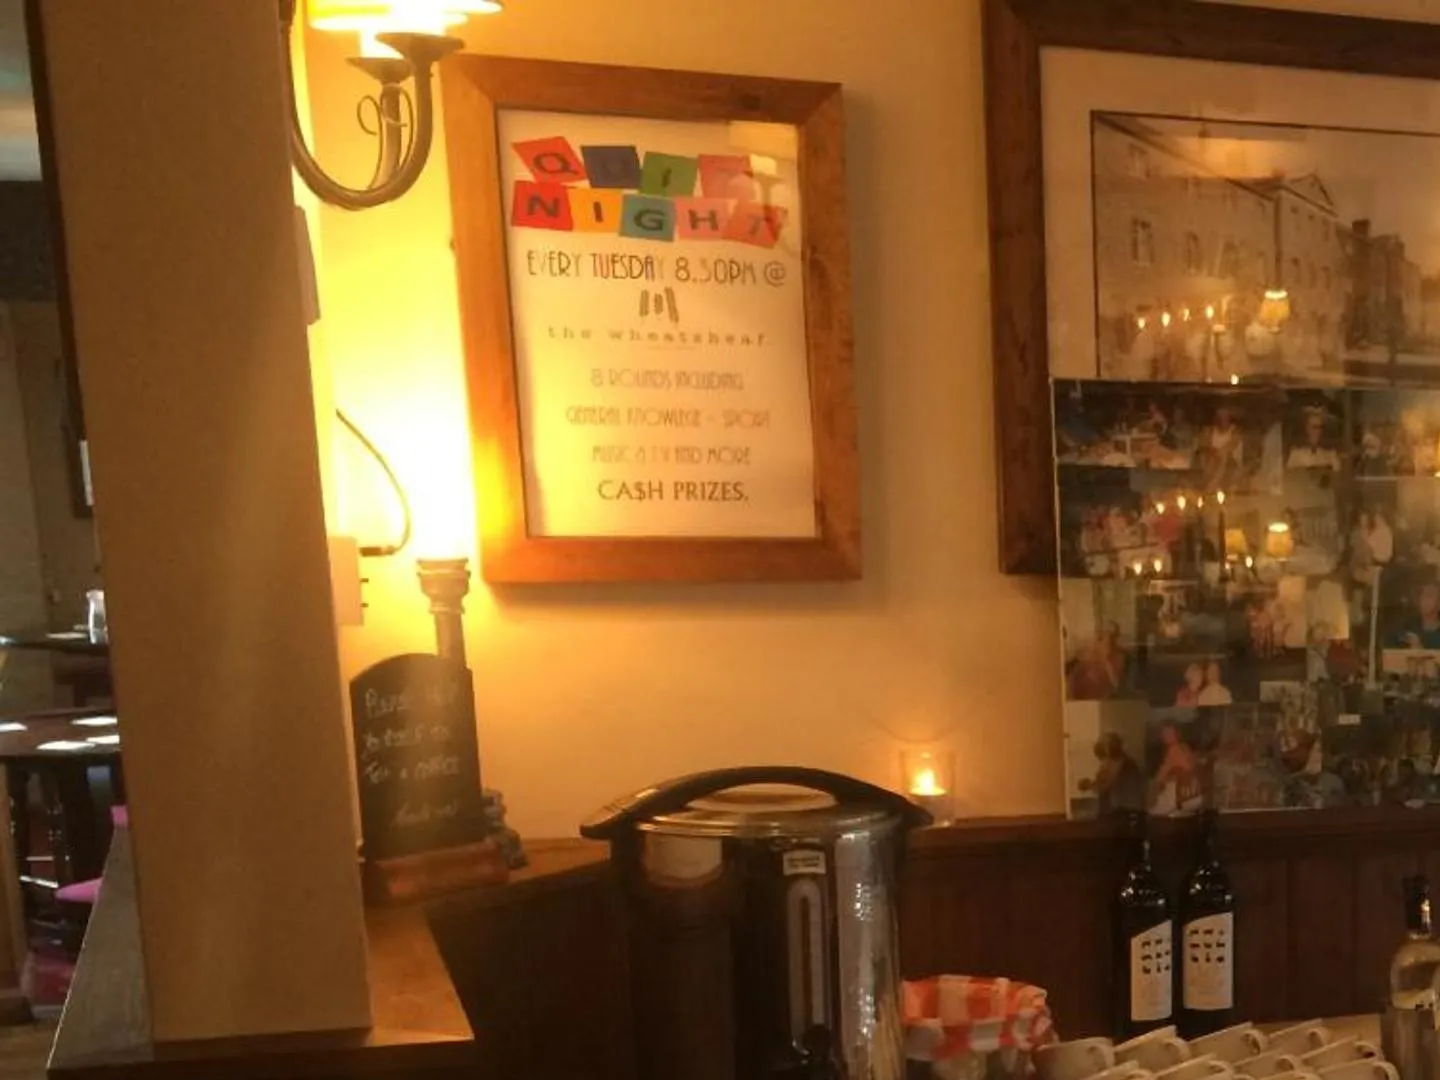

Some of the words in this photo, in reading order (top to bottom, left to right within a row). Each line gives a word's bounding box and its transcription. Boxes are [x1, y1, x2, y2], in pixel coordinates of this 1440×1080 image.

[525, 194, 788, 238] NIGHT
[527, 250, 582, 277] EVERY
[590, 252, 665, 281] TUESDAY
[547, 326, 592, 340] the
[597, 479, 664, 503] CA$H
[673, 481, 749, 503] PRIZES.
